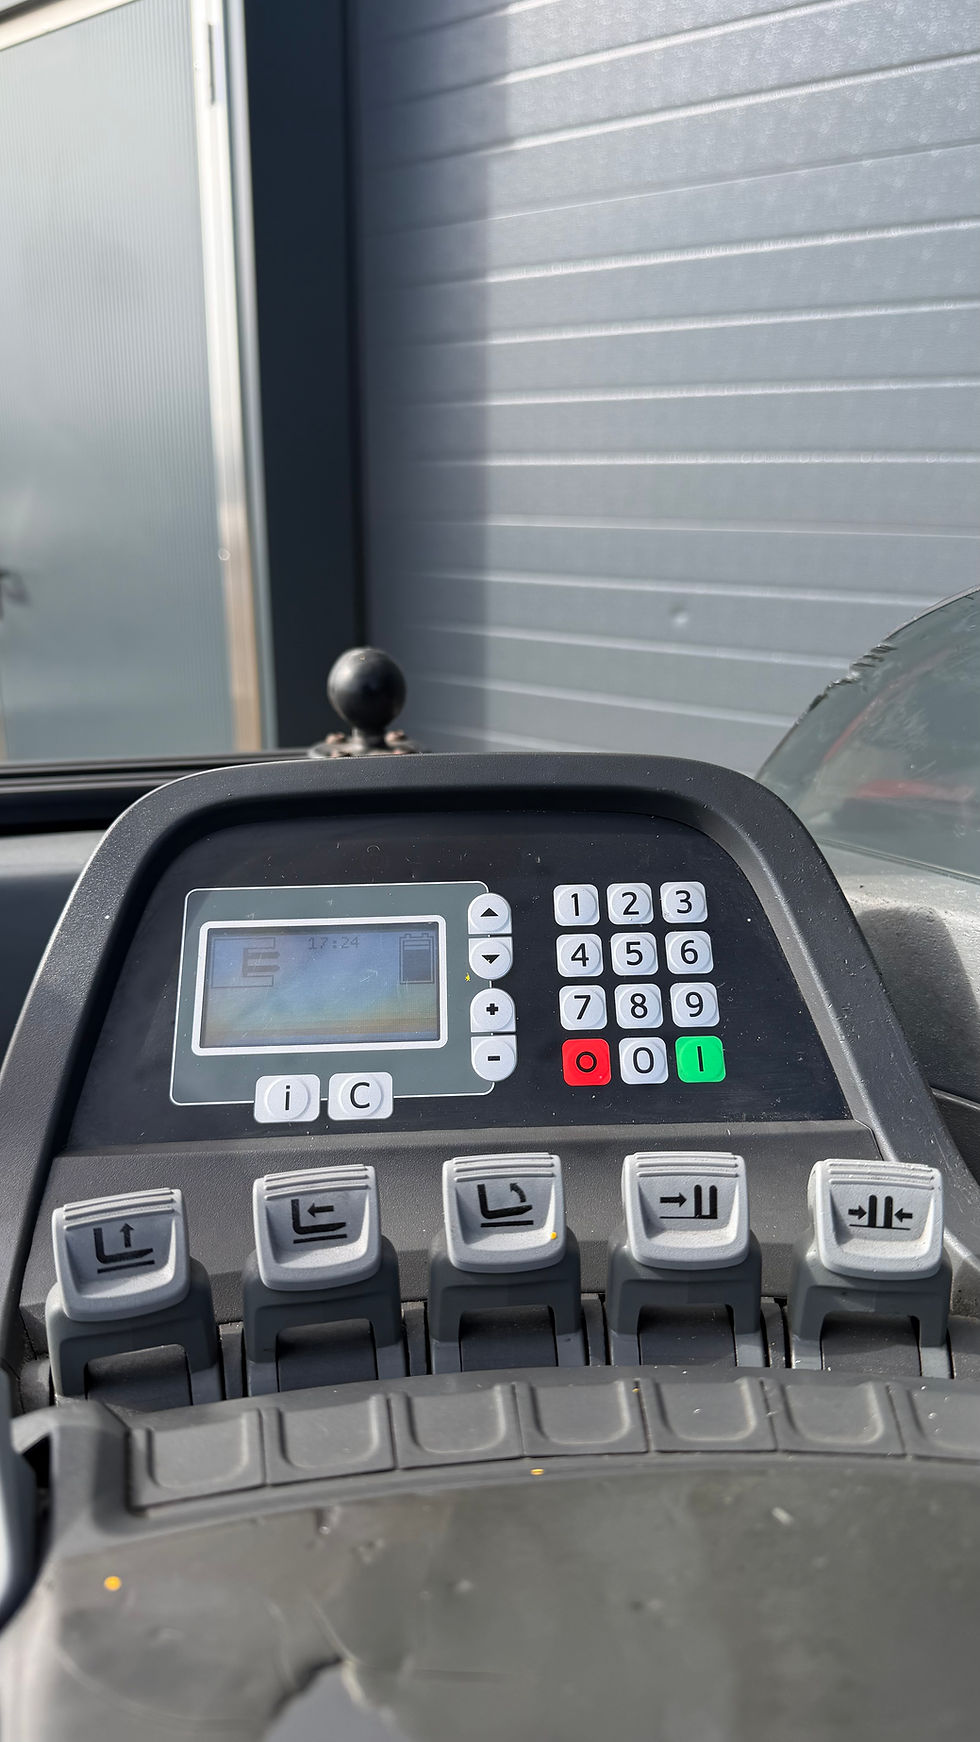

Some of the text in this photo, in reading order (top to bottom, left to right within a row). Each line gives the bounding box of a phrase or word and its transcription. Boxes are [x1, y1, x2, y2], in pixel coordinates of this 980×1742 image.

[571, 890, 692, 916] 1 2 3
[307, 935, 360, 951] 17:24
[570, 940, 698, 967] 4 5 6
[573, 991, 704, 1020] 7 8 9
[349, 1081, 370, 1109] C
